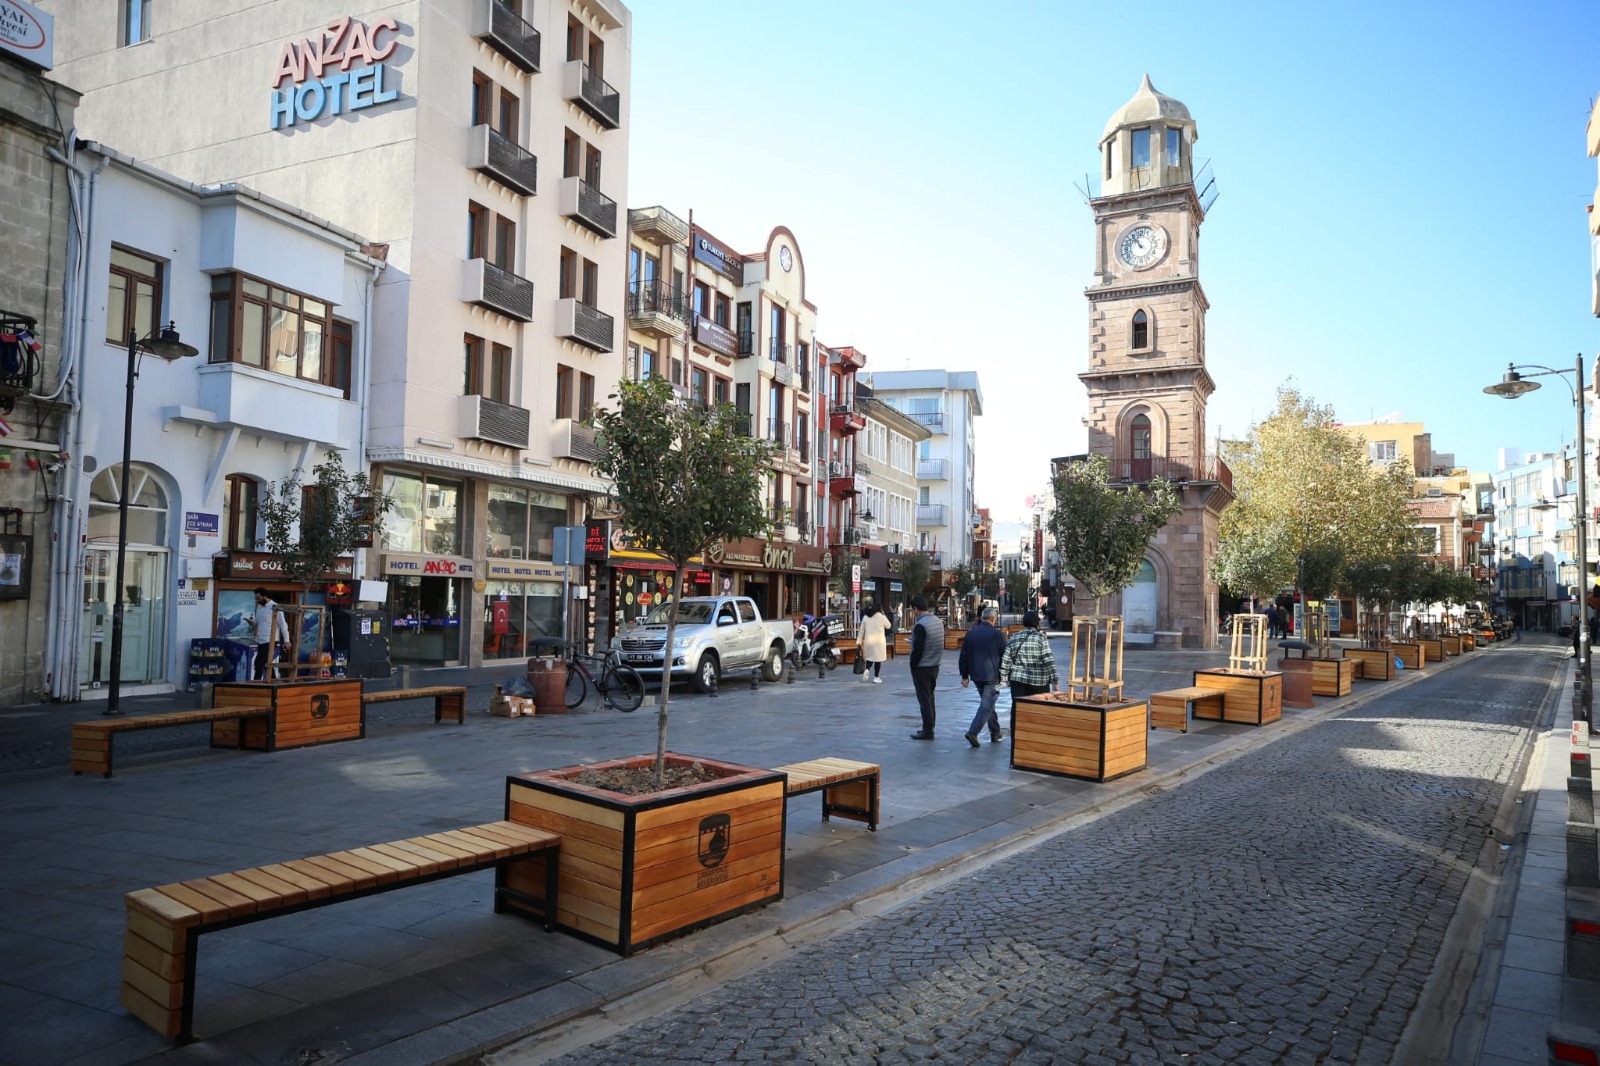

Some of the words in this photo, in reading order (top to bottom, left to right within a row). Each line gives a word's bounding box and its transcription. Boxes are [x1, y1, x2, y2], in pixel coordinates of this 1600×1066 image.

[272, 15, 400, 89] ANZAC
[270, 63, 400, 130] HOTEL
[390, 561, 420, 570] HOTEL
[458, 564, 474, 572] HOTEL
[492, 566, 511, 575] HOTEL
[534, 569, 552, 577] HOTEL
[696, 873, 729, 889] BELEDİYESİ
